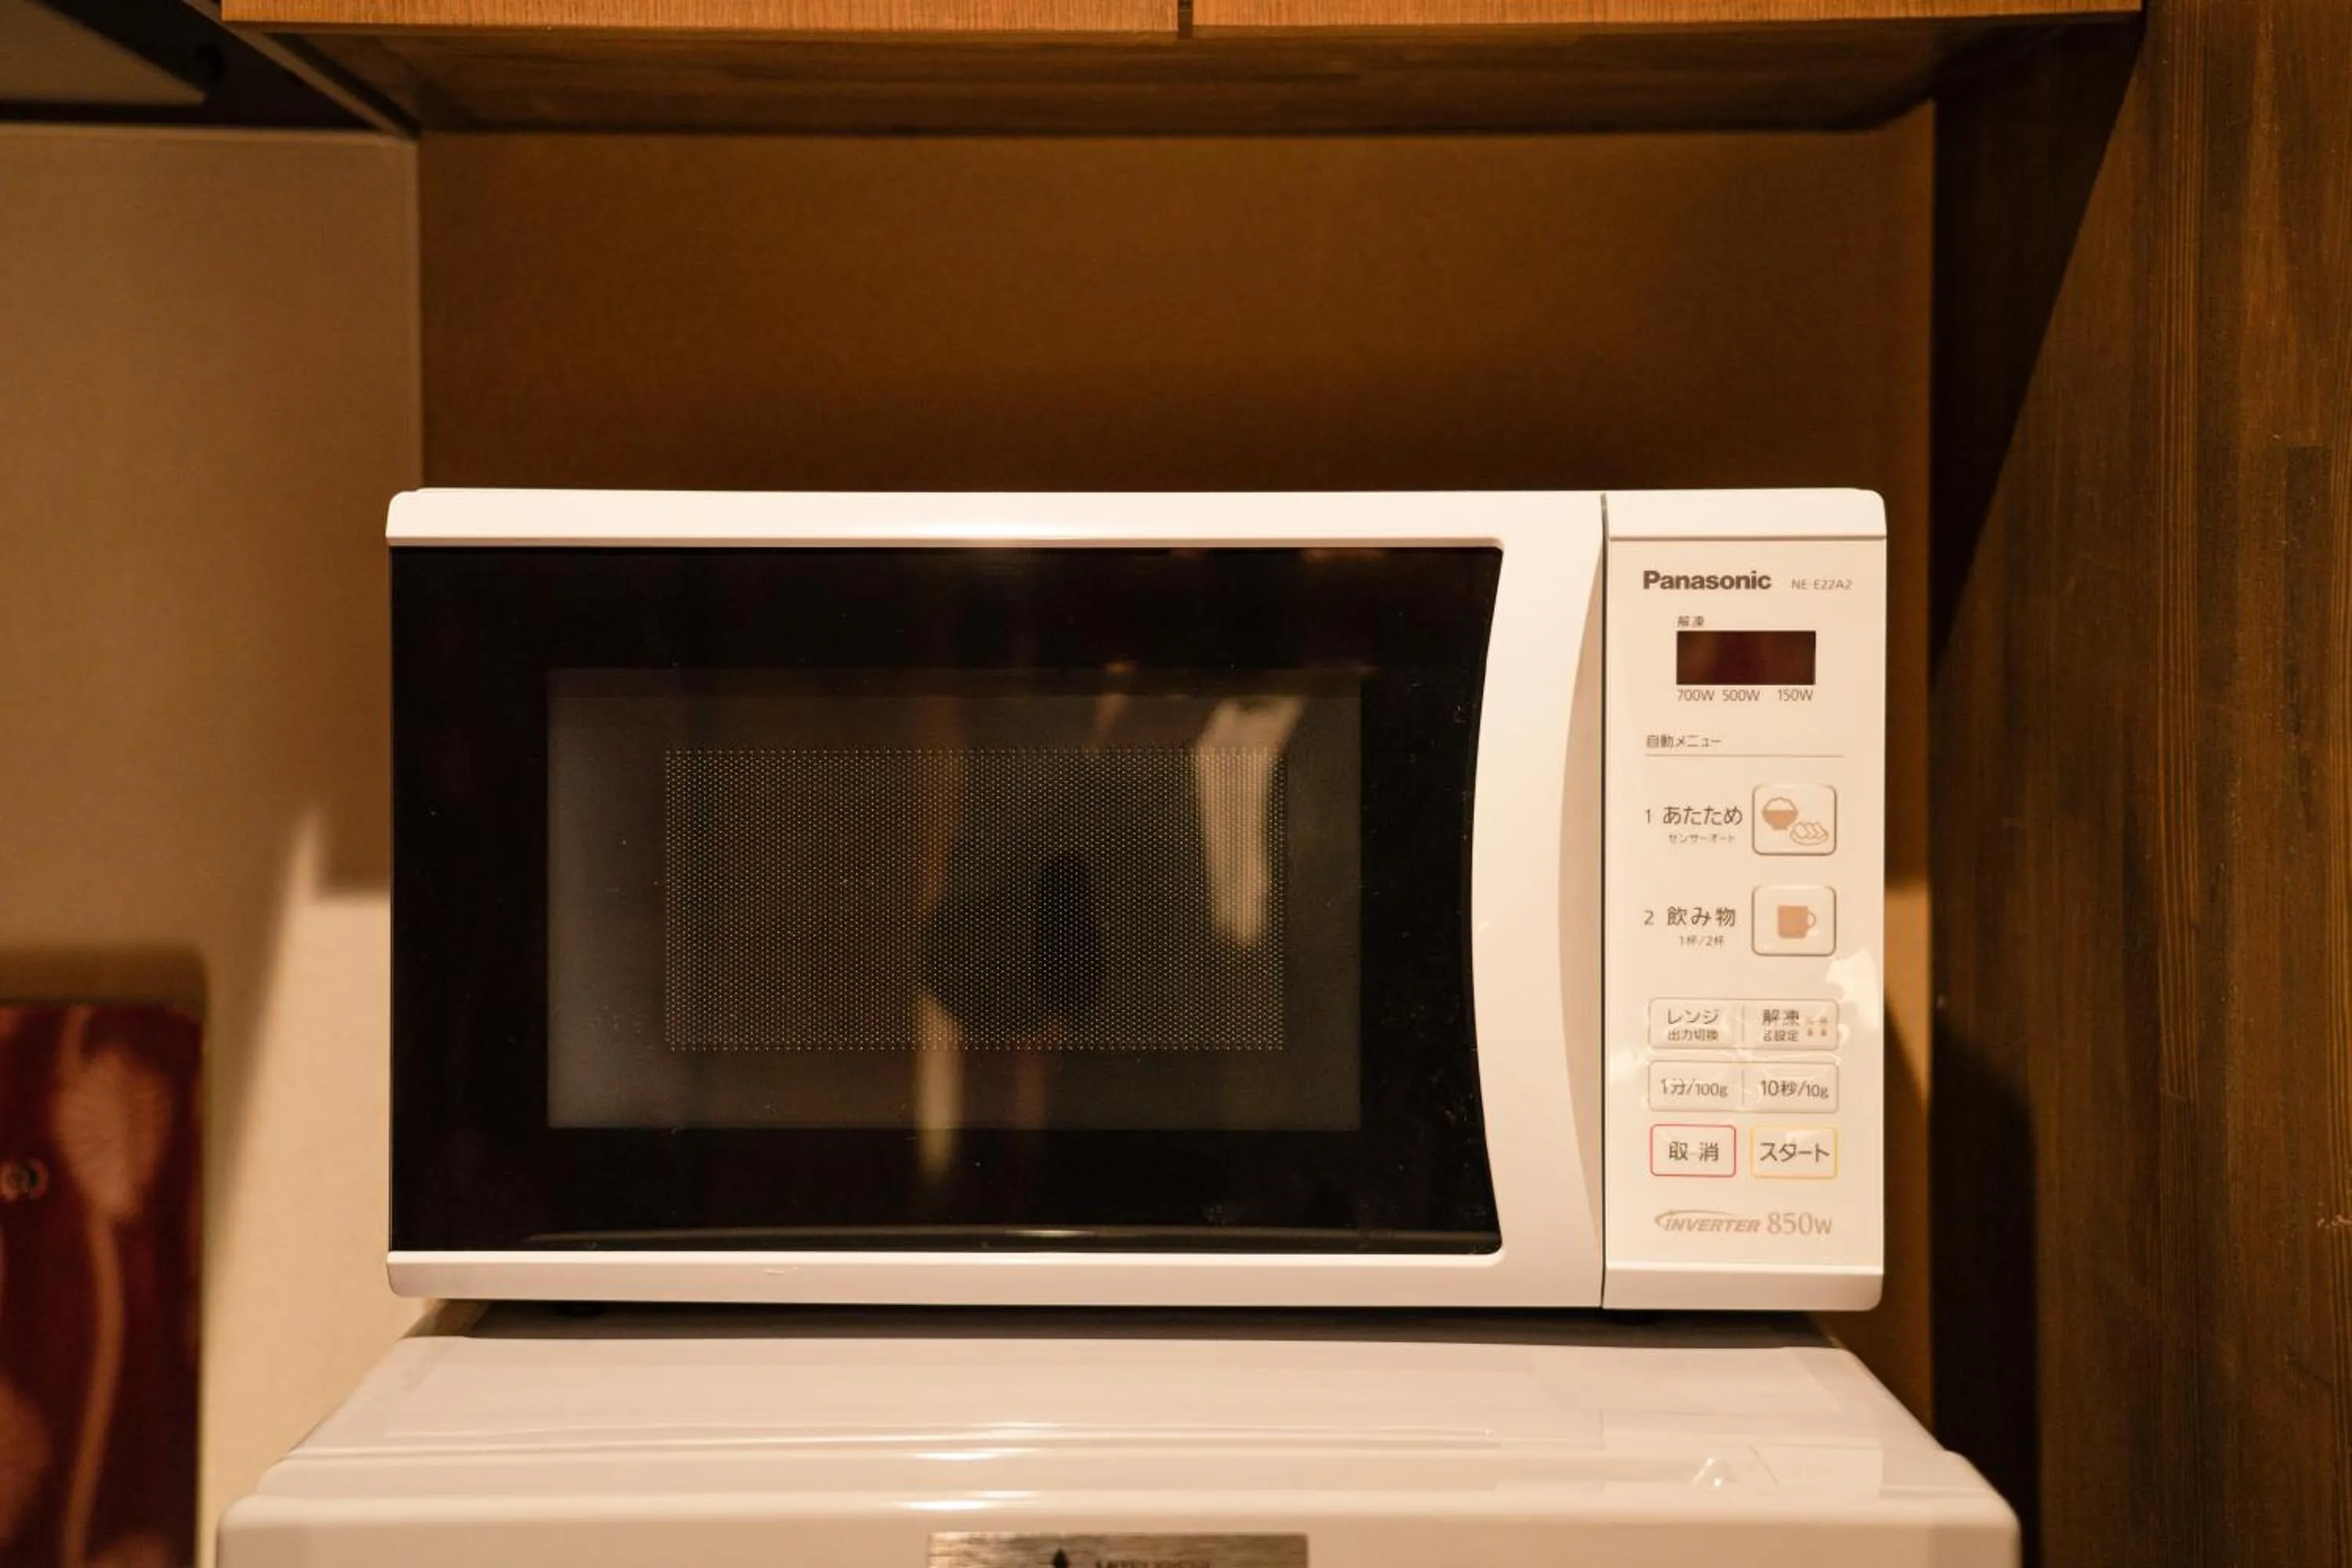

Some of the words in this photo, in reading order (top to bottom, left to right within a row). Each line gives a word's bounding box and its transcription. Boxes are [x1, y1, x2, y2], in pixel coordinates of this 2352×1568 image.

[1642, 570, 1772, 590] Panasonic
[1678, 689, 1715, 702] 700W
[1722, 689, 1760, 702] 500W
[1777, 689, 1813, 702] 150W
[1646, 734, 1722, 749] 自動メニュー
[1646, 809, 1652, 823] 1
[1663, 805, 1743, 826] あたため
[1644, 910, 1654, 925] 2
[1667, 906, 1737, 927] 飲み物
[1668, 1008, 1719, 1025] レンジ
[1762, 1009, 1800, 1026] 解凍
[1761, 1079, 1830, 1099] 10秒/10g
[1760, 1142, 1830, 1163] スタート
